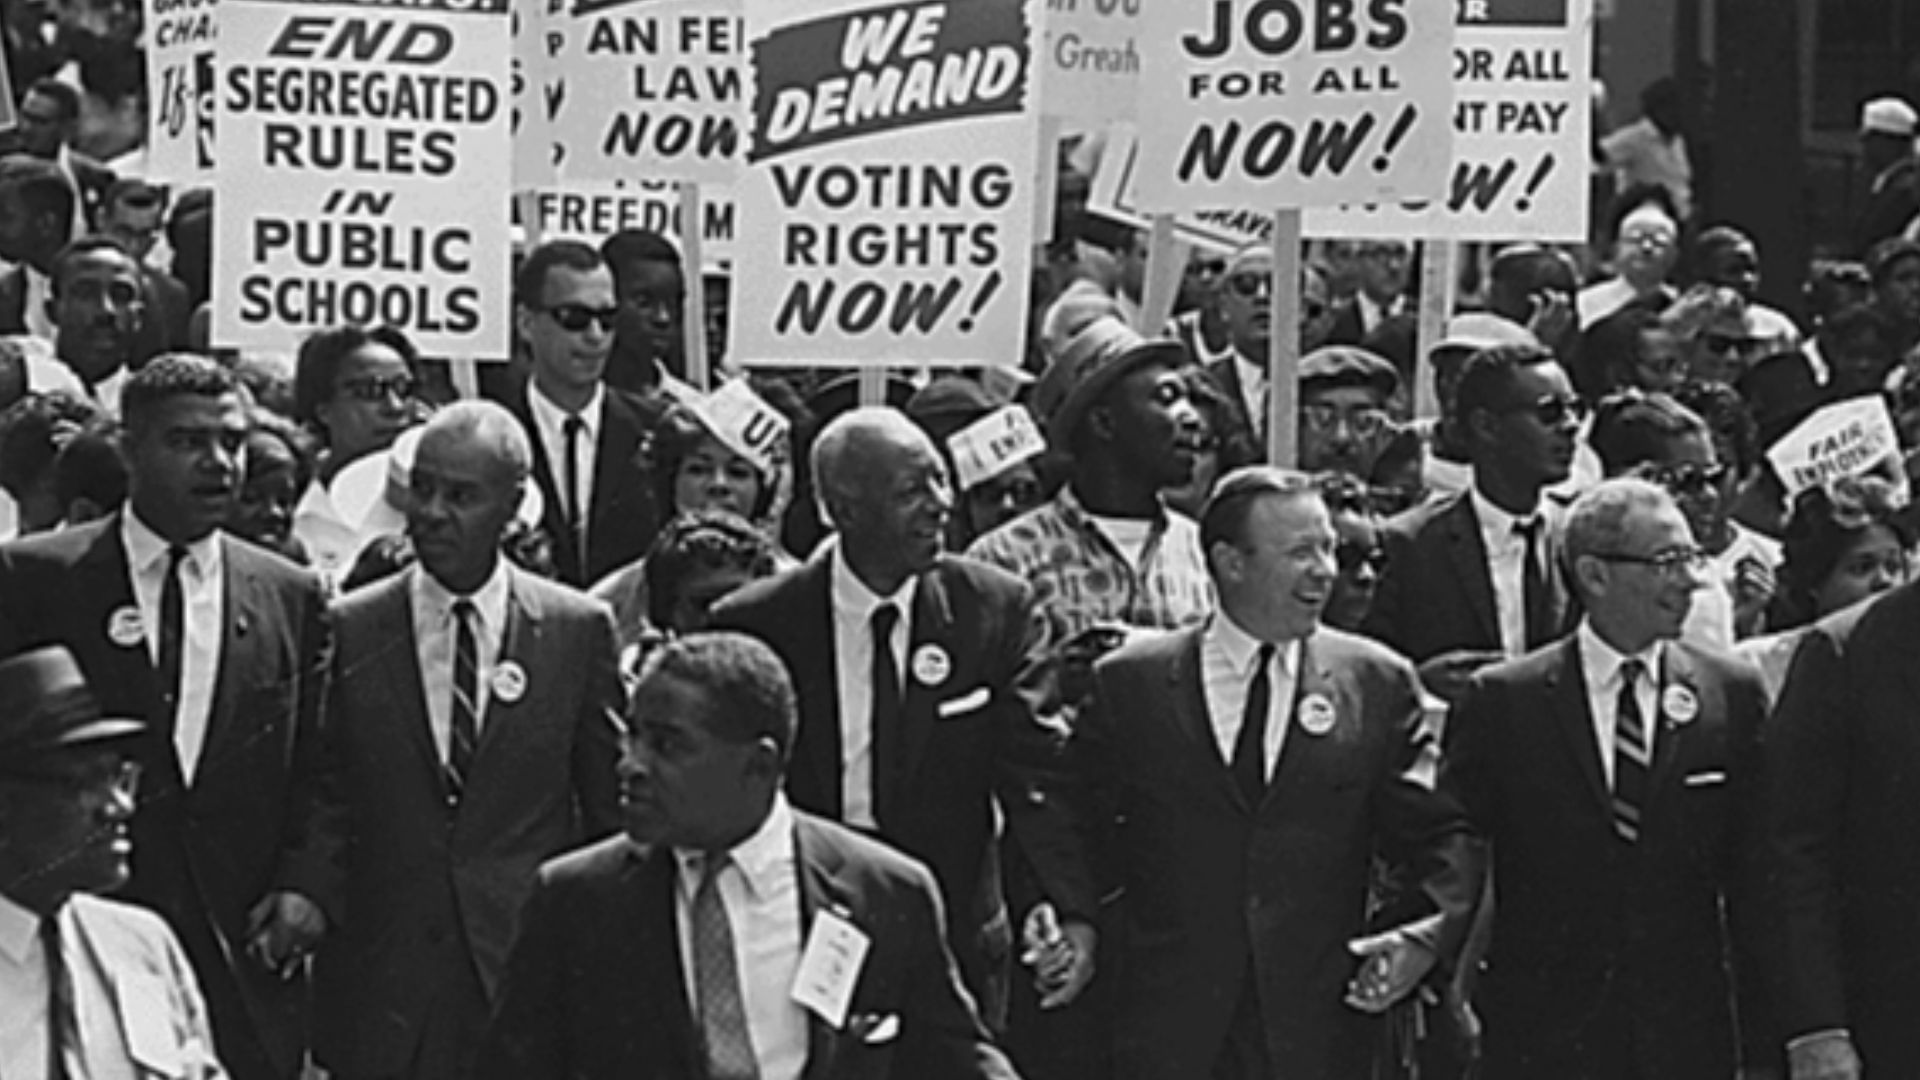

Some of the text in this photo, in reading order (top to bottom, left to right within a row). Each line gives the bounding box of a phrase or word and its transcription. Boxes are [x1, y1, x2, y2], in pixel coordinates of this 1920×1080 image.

[156, 13, 218, 48] CHA
[267, 16, 455, 65] END
[586, 16, 744, 54] AN FE
[842, 4, 946, 70] WE
[1181, 0, 1408, 58] JOBS
[1189, 64, 1400, 99] FOR ALL
[1503, 49, 1569, 81] ALL
[226, 66, 499, 124] SEGREGATED
[766, 46, 1020, 144] DEMAND
[1497, 100, 1569, 133] PAY
[264, 123, 457, 176] RULES
[1178, 102, 1418, 182] NOW!
[321, 189, 395, 216] IN
[769, 163, 1014, 209] VOTING
[540, 192, 735, 240] FREEDM
[253, 218, 472, 274] PUBLIC
[784, 222, 999, 267] RIGHTS
[239, 275, 480, 333] SCHOOLS
[775, 269, 1003, 335] NOW!
